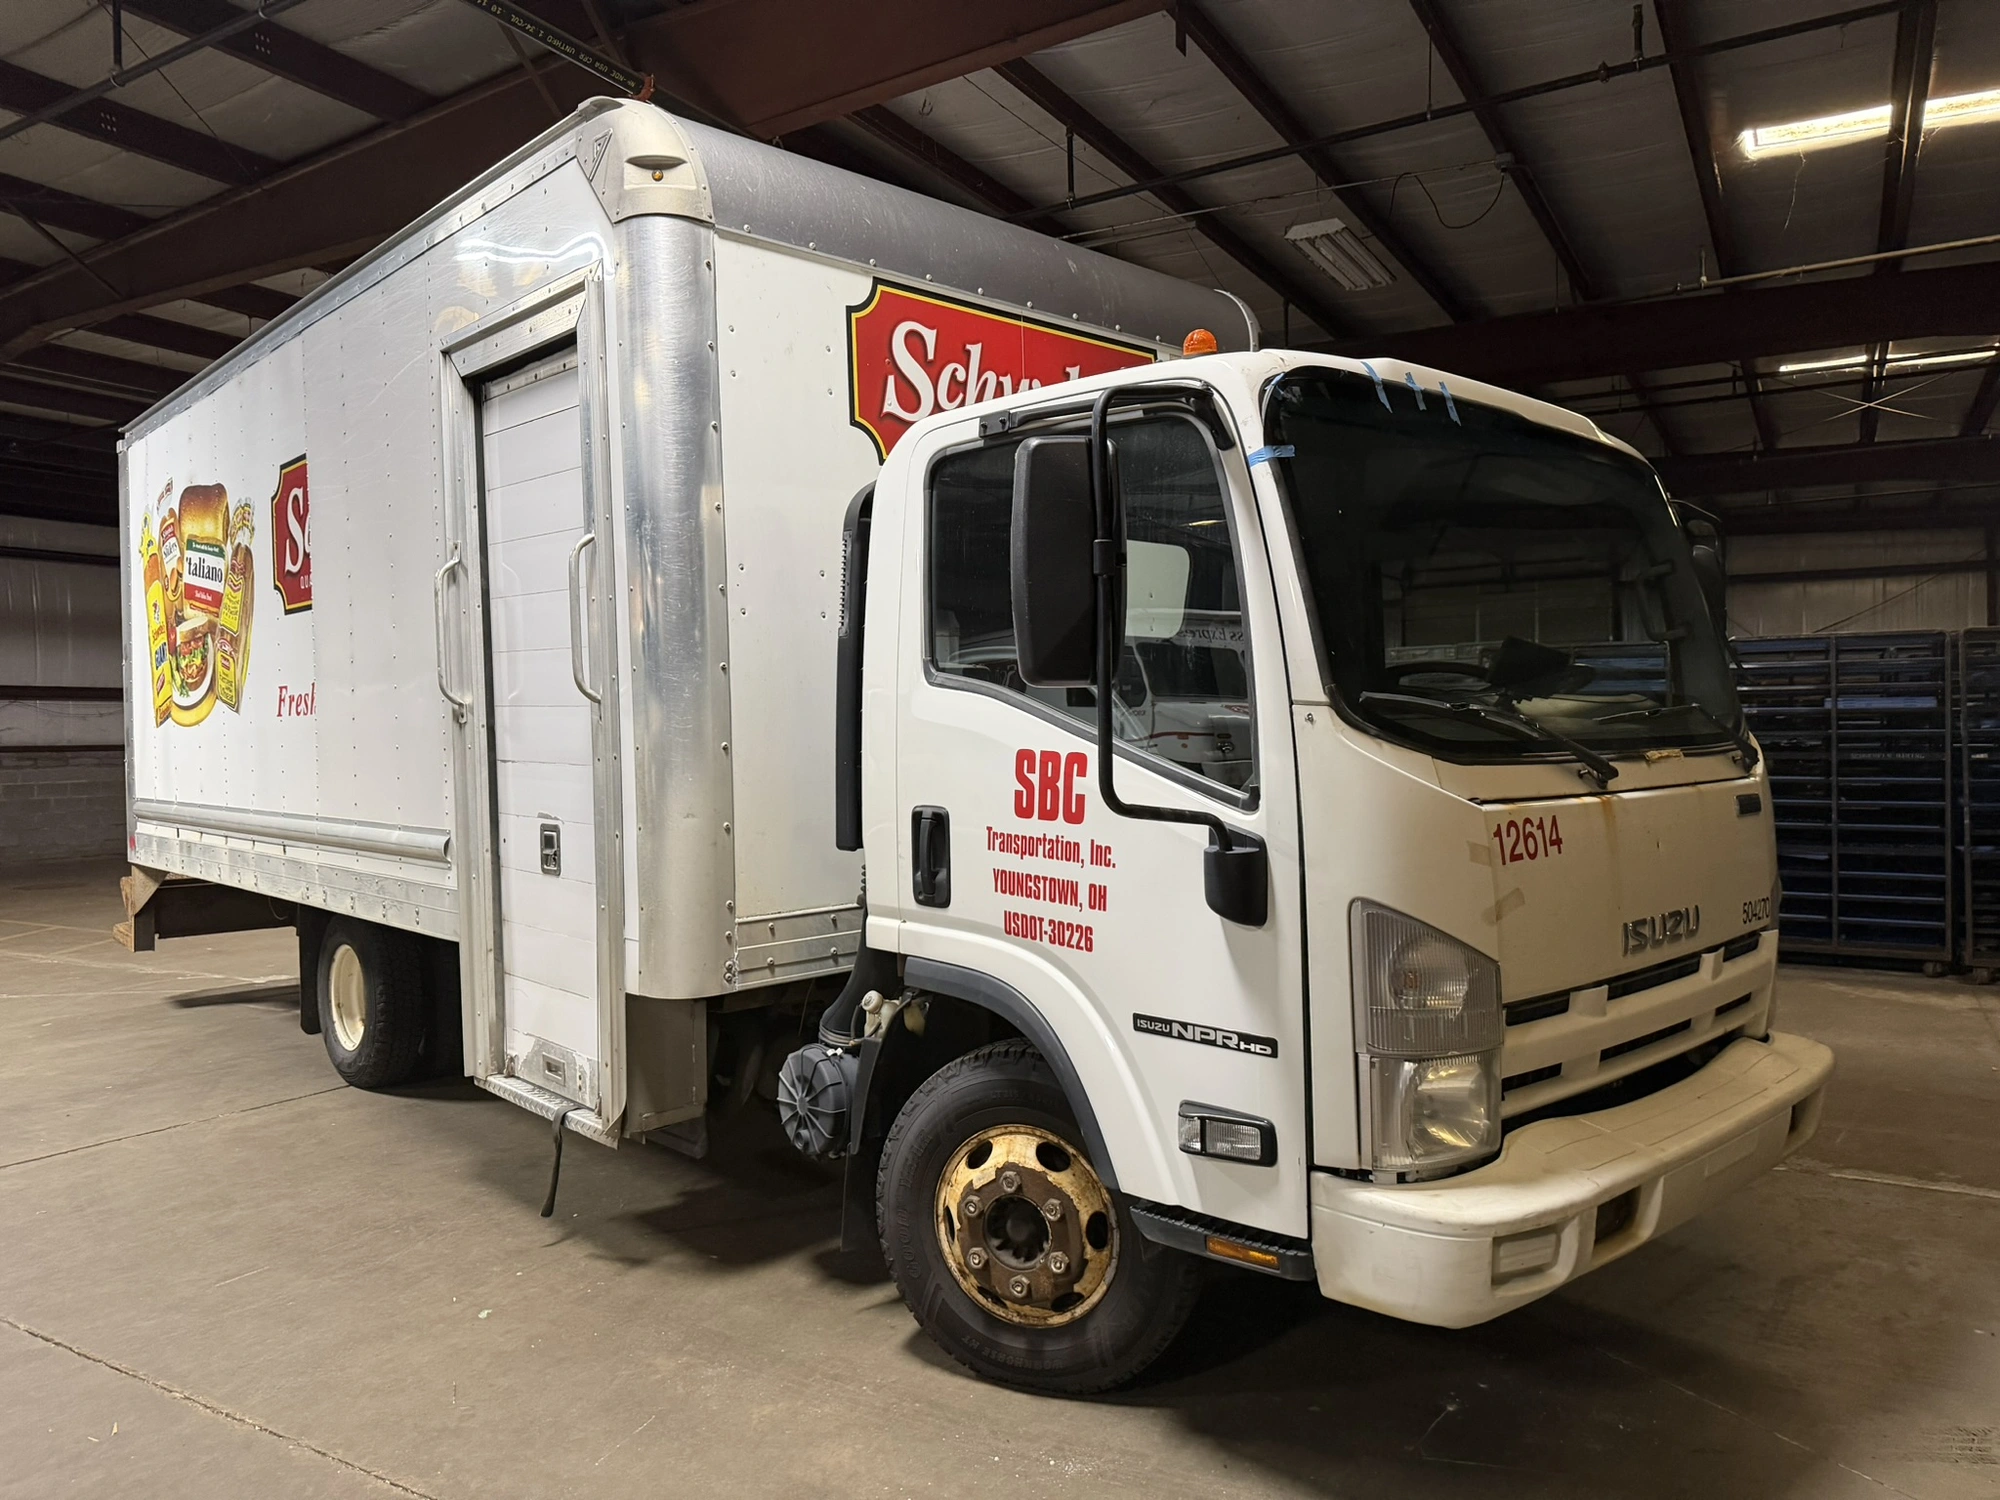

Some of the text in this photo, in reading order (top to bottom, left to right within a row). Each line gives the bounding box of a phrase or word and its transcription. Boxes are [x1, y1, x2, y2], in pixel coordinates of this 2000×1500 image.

[1013, 747, 1089, 826] SBC
[985, 826, 1117, 869] Transportation, Inc.
[1493, 814, 1564, 866] 12614
[992, 867, 1108, 913] YOUNGSTOWN, OH
[1742, 896, 1771, 925] 504270
[1003, 909, 1094, 953] USDOT-30226
[1621, 904, 1701, 957] ISUZU
[1136, 1018, 1171, 1033] ISUZU
